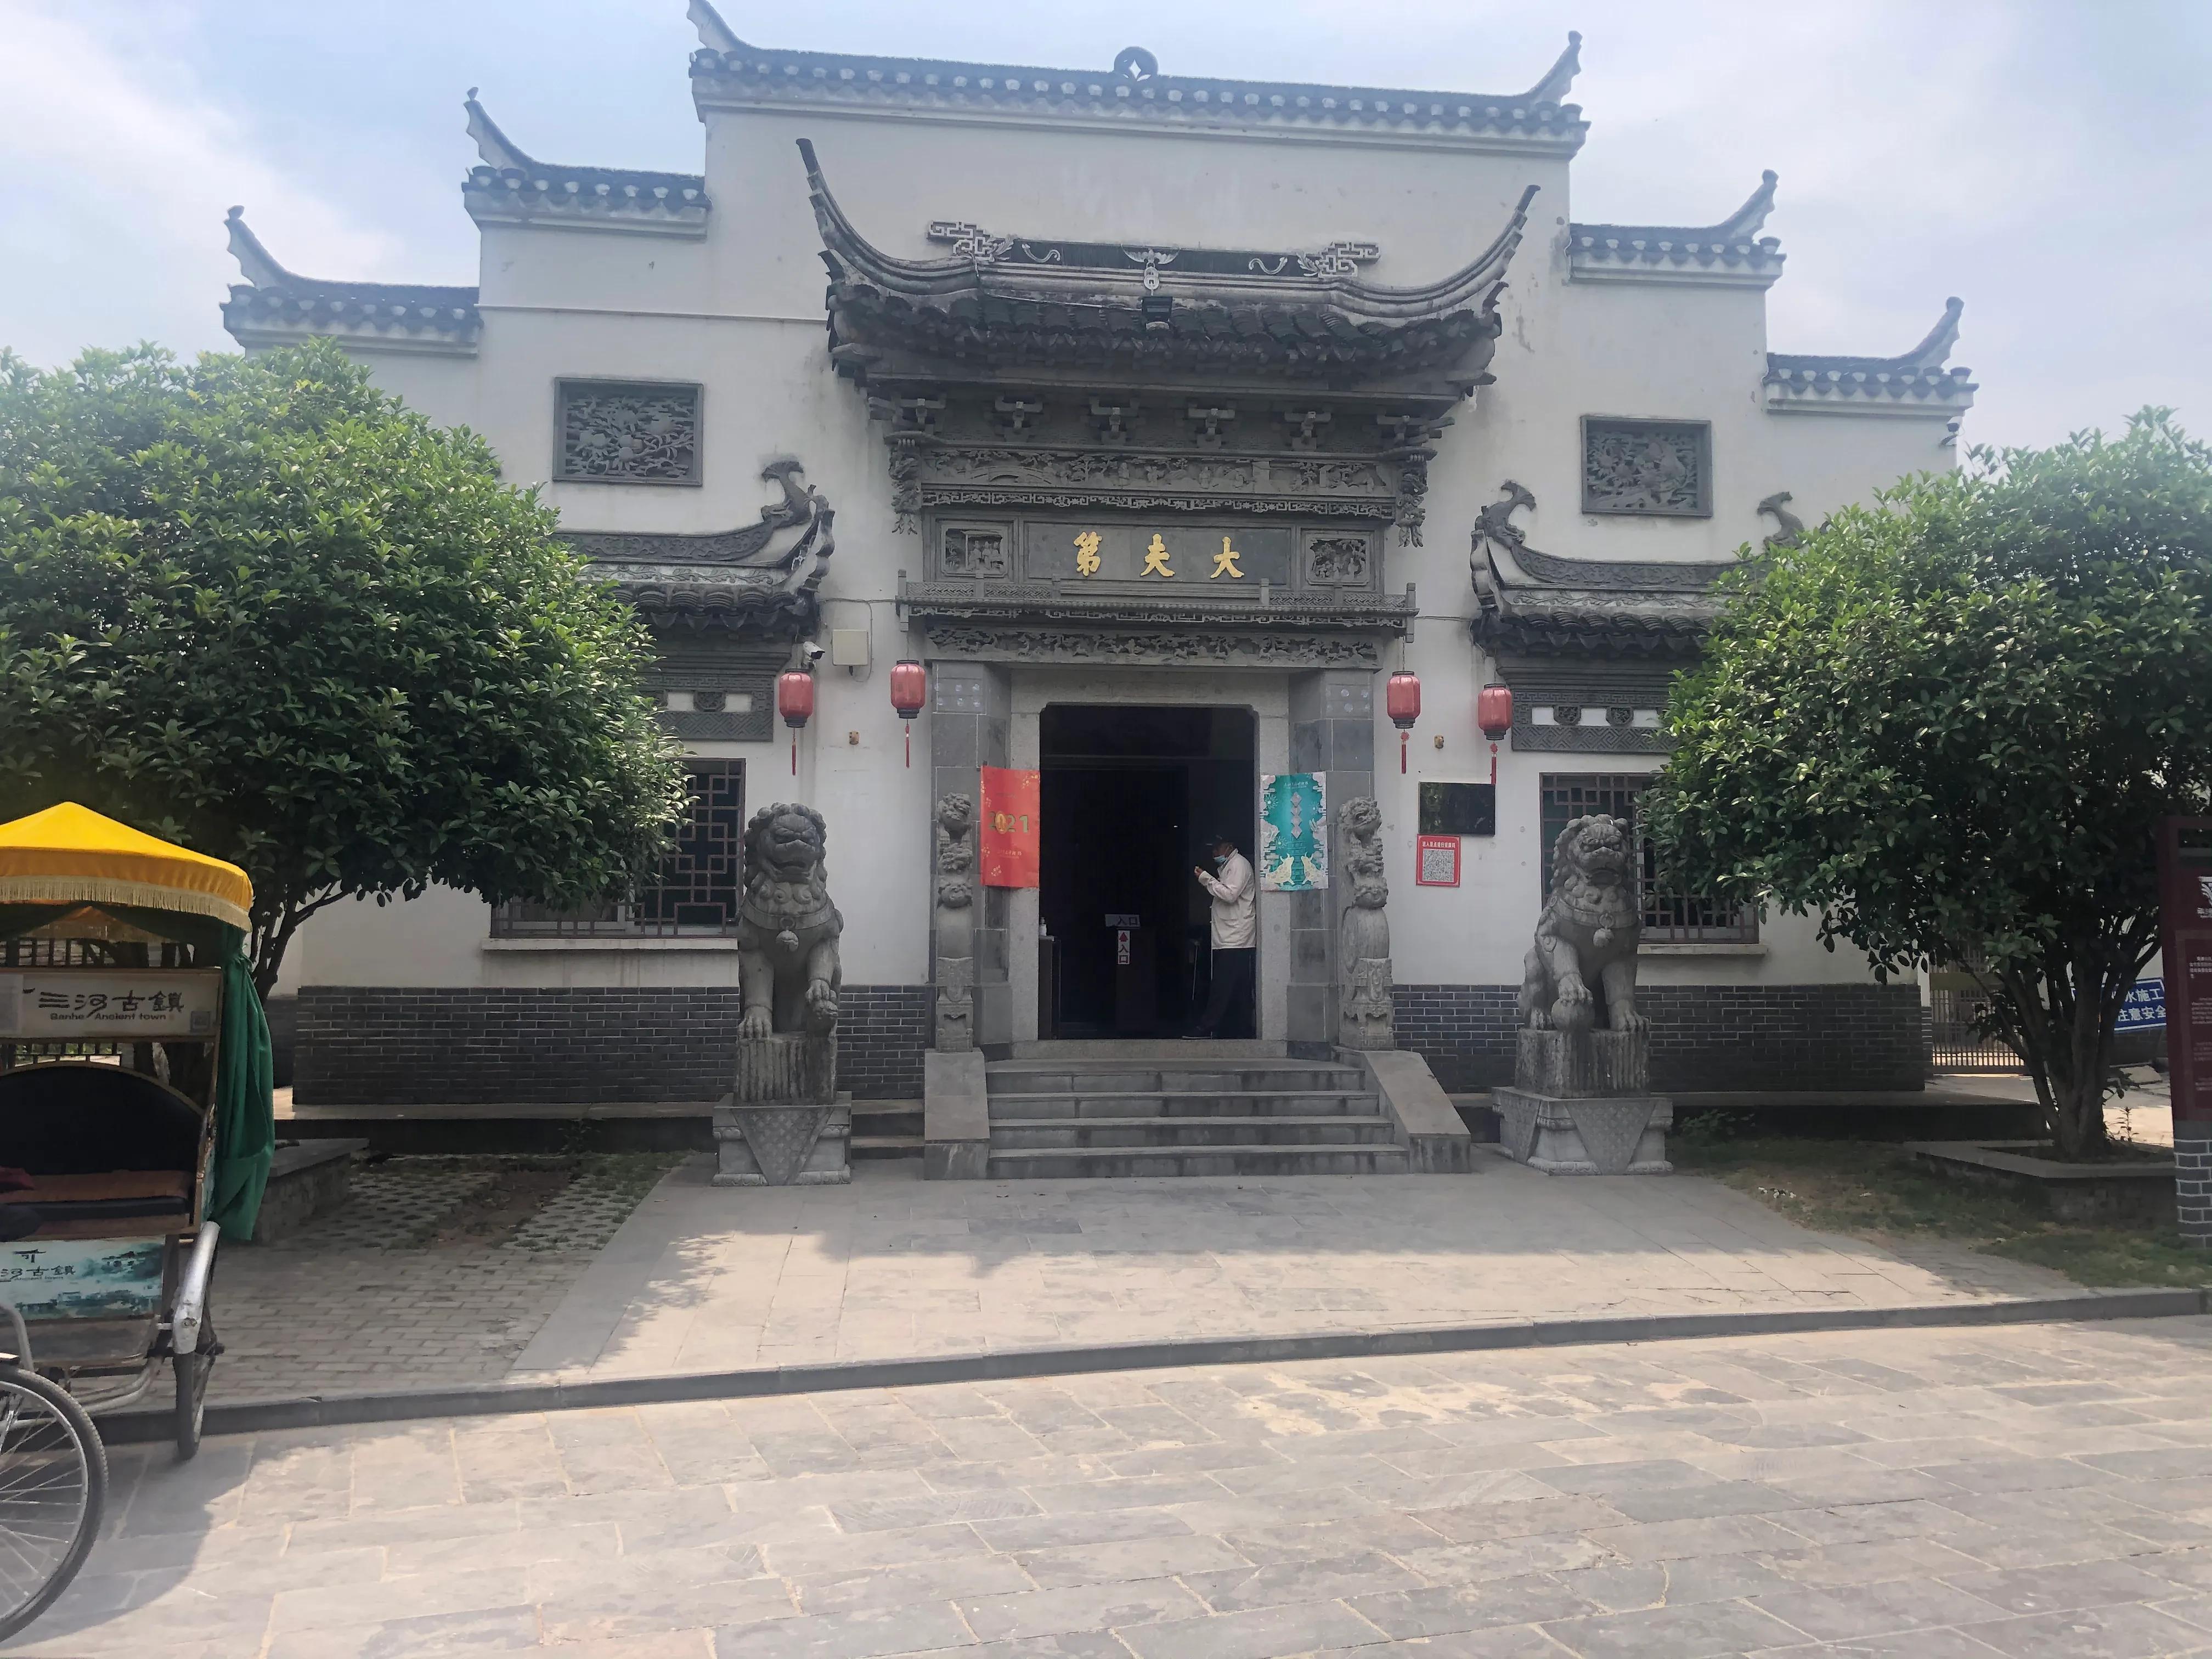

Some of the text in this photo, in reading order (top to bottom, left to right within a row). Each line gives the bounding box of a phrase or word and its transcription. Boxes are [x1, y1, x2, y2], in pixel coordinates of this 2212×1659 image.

[989, 811, 1029, 834] 2021
[1117, 916, 1138, 926] 入口
[1118, 944, 1129, 963] 入口
[2112, 988, 2164, 1003] 水施工
[2118, 1005, 2166, 1022] 注意安全
